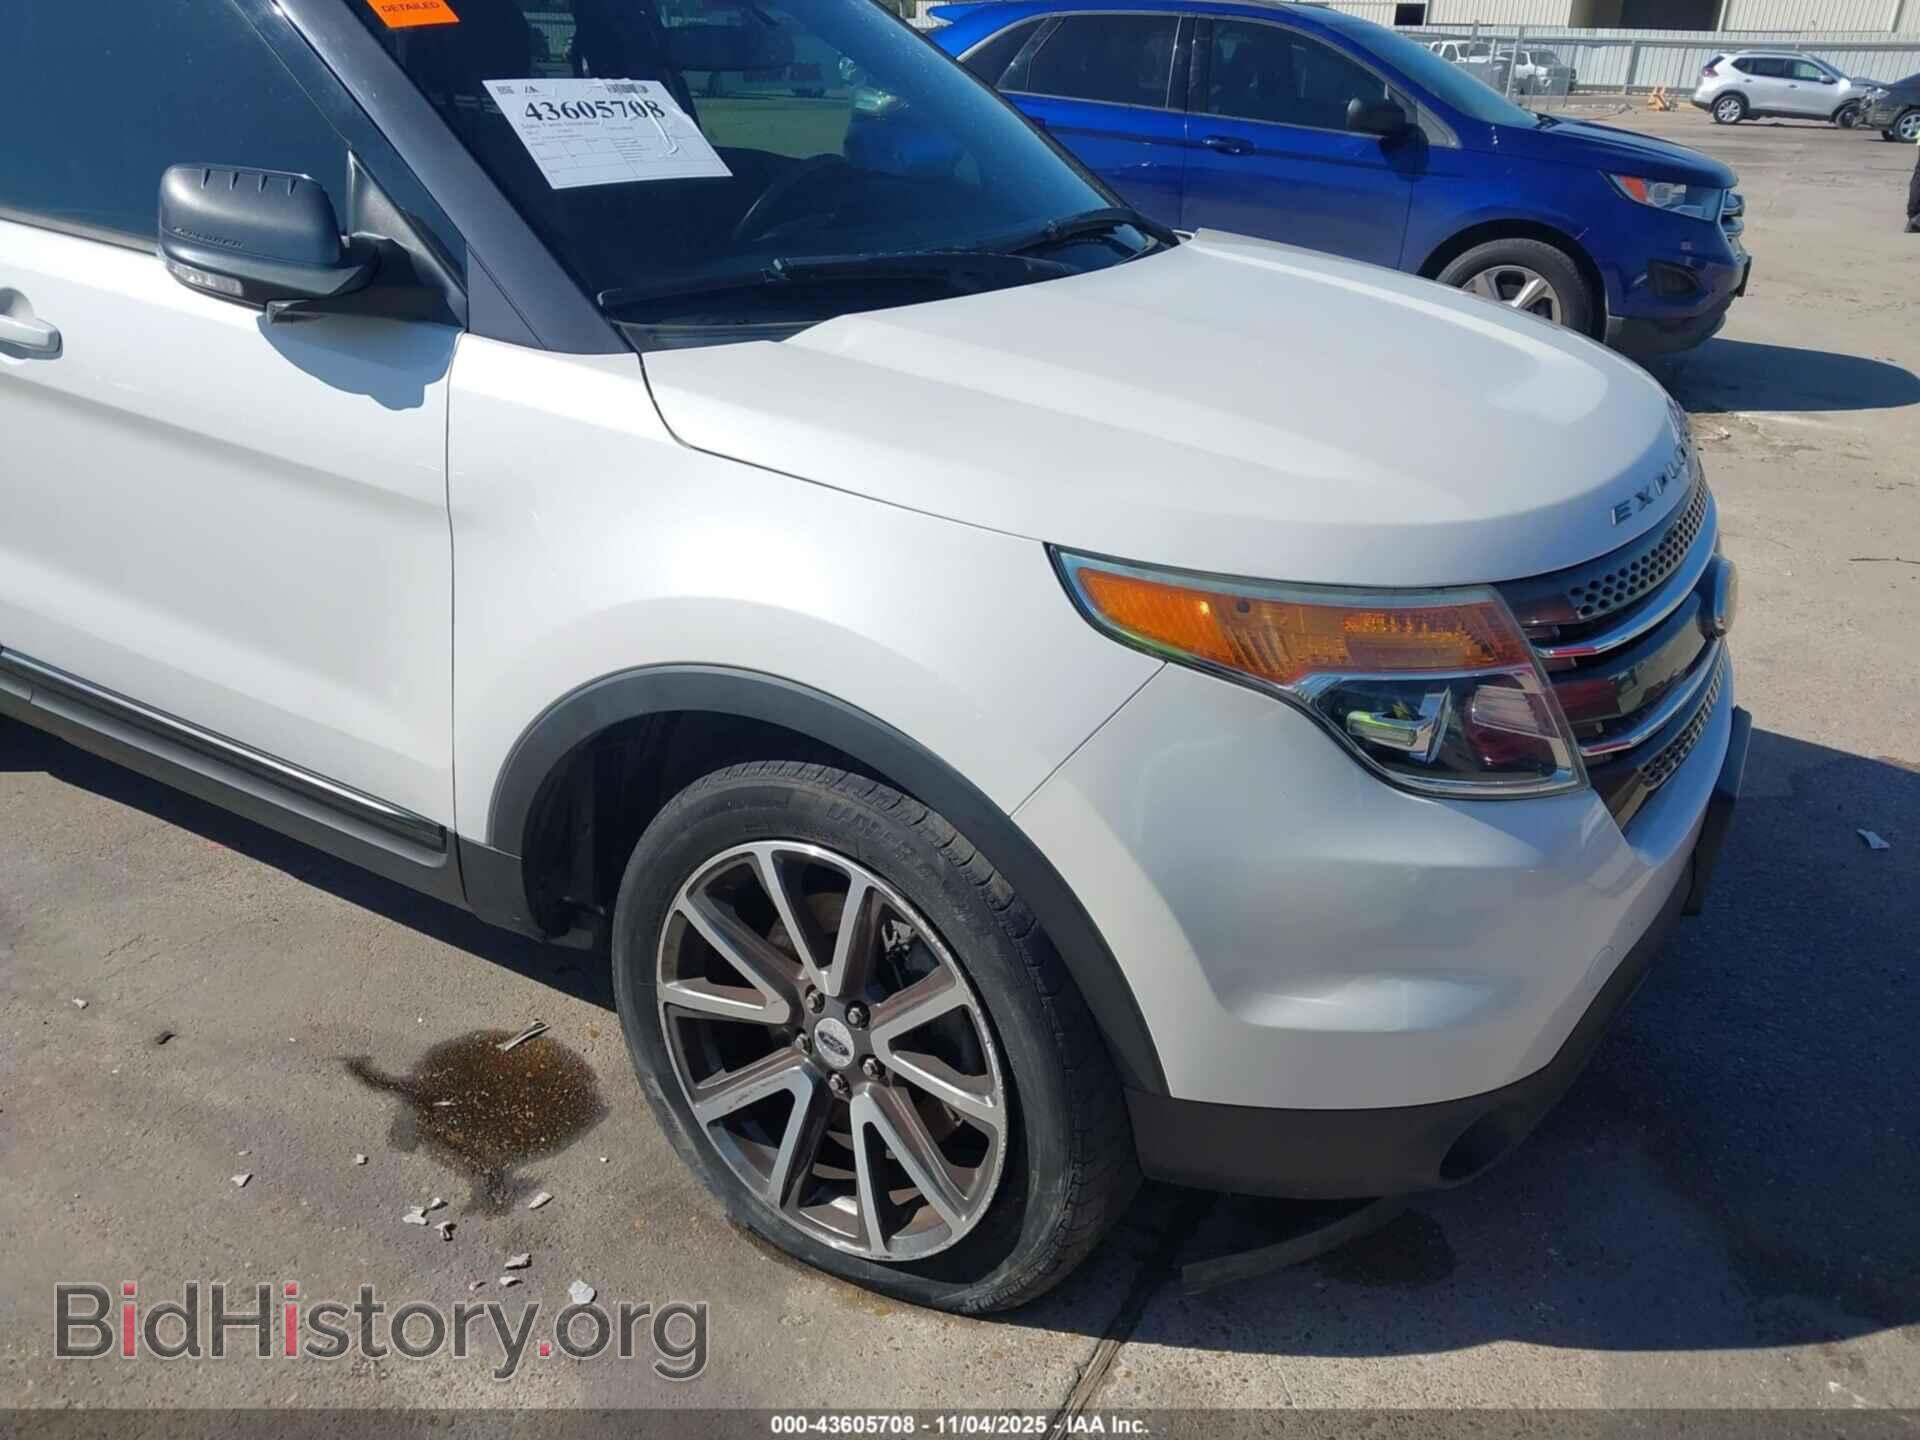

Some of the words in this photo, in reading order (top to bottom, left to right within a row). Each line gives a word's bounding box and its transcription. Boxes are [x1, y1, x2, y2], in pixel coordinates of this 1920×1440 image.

[381, 1, 440, 12] DETAILED
[524, 100, 666, 122] 43605708
[1610, 434, 1691, 527] EXPLO
